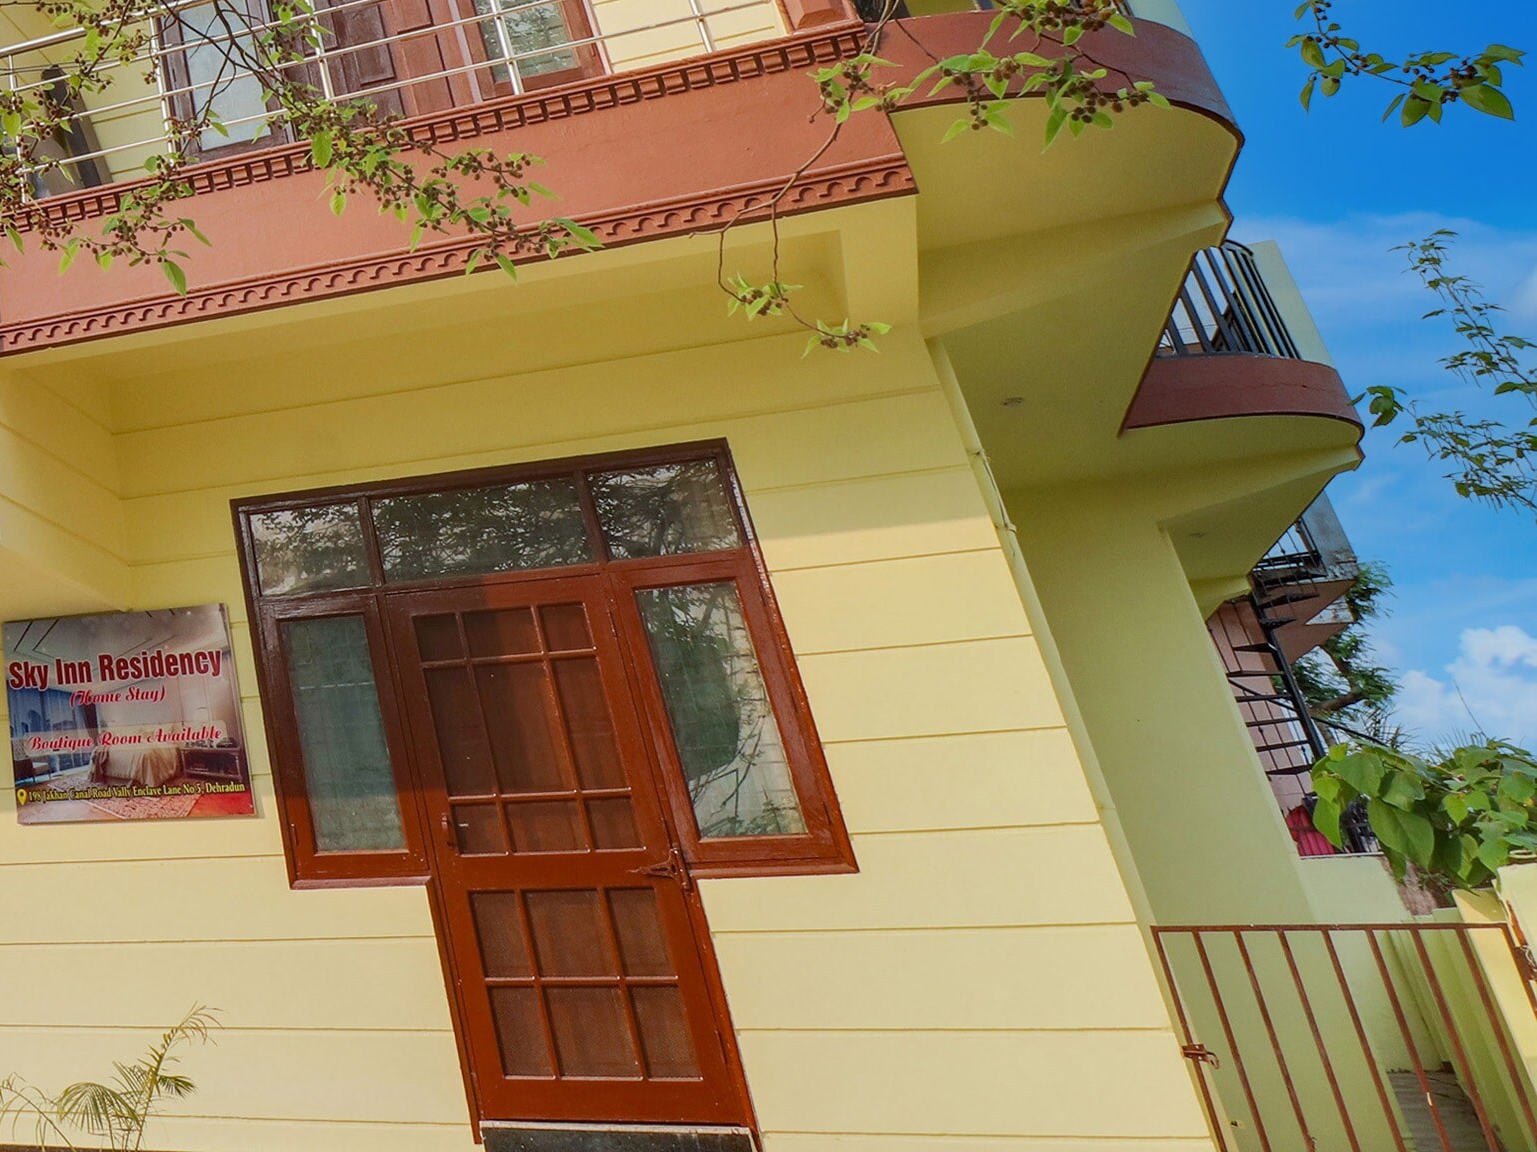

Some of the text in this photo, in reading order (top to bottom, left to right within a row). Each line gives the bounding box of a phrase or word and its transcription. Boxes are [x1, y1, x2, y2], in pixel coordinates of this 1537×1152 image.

[8, 650, 221, 690] Sky Inn Residency
[69, 686, 166, 707] (Home Stay)
[29, 726, 222, 751] Boutique Room Available
[69, 788, 90, 799] Canal
[93, 786, 112, 798] Road
[133, 785, 161, 796] Enclave
[163, 784, 181, 795] Lane
[183, 784, 194, 794] No
[206, 781, 245, 793] Dehradun
